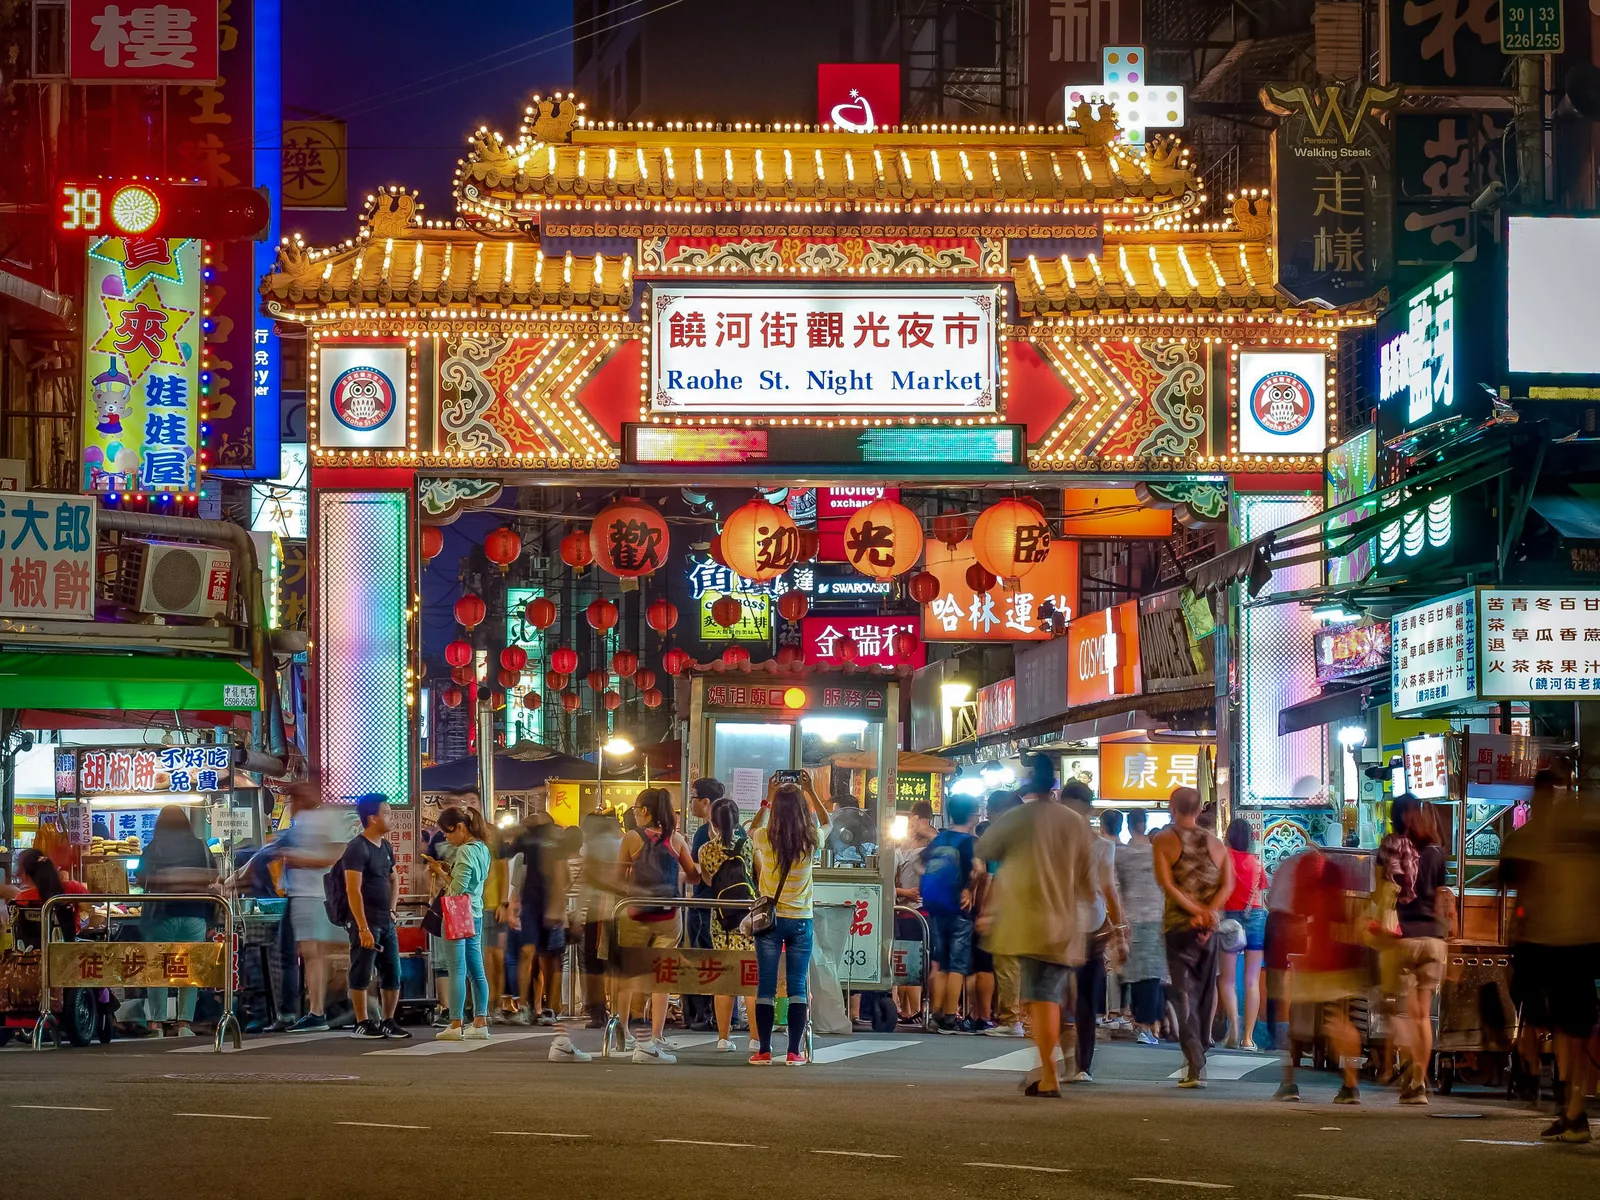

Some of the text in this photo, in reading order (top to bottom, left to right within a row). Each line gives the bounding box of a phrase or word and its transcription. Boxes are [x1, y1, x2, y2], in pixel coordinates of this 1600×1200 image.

[91, 4, 198, 68] 樓
[1509, 8, 1555, 22] 30 33
[1506, 34, 1560, 48] 226 255
[282, 136, 325, 190] 藥
[1294, 147, 1371, 159] Walking Steak
[1303, 136, 1338, 145] Personal
[1312, 171, 1365, 272] 走樣
[115, 303, 169, 358] 夾
[667, 310, 981, 349] 饒河街觀光夜市
[667, 368, 983, 396] Raohe St. Night Market
[143, 374, 190, 487] 娃娃屋
[829, 487, 885, 498] money
[610, 519, 662, 571] 歡
[756, 525, 800, 572] 迎
[846, 521, 896, 568] 光
[1015, 523, 1051, 564] 臨
[0, 555, 92, 611] 椒餅
[212, 571, 228, 600] 禾聯
[832, 583, 890, 593] SWAROVSKI
[1410, 615, 1418, 687] 青草茶
[1418, 613, 1427, 686] 冬瓜茶
[1427, 610, 1436, 684] 百香果
[1436, 607, 1445, 683] 甘蔗汁
[1445, 604, 1454, 680] 楊桃汁
[1465, 598, 1476, 692] 實在老口味
[1487, 598, 1506, 674] 苦茶退火
[1511, 598, 1530, 674] 青草茶
[1535, 598, 1554, 674] 冬瓜茶
[1559, 598, 1578, 674] 百香果
[708, 686, 786, 706] 媽祖廟口
[822, 688, 884, 709] 服務台
[83, 752, 156, 791] 胡椒餅
[161, 748, 229, 769] 不好吃
[170, 770, 218, 793] 免費
[896, 783, 928, 797] 椒餅
[78, 951, 190, 980] 徒步區
[652, 956, 760, 987] 徒步區
[844, 949, 866, 966] 33
